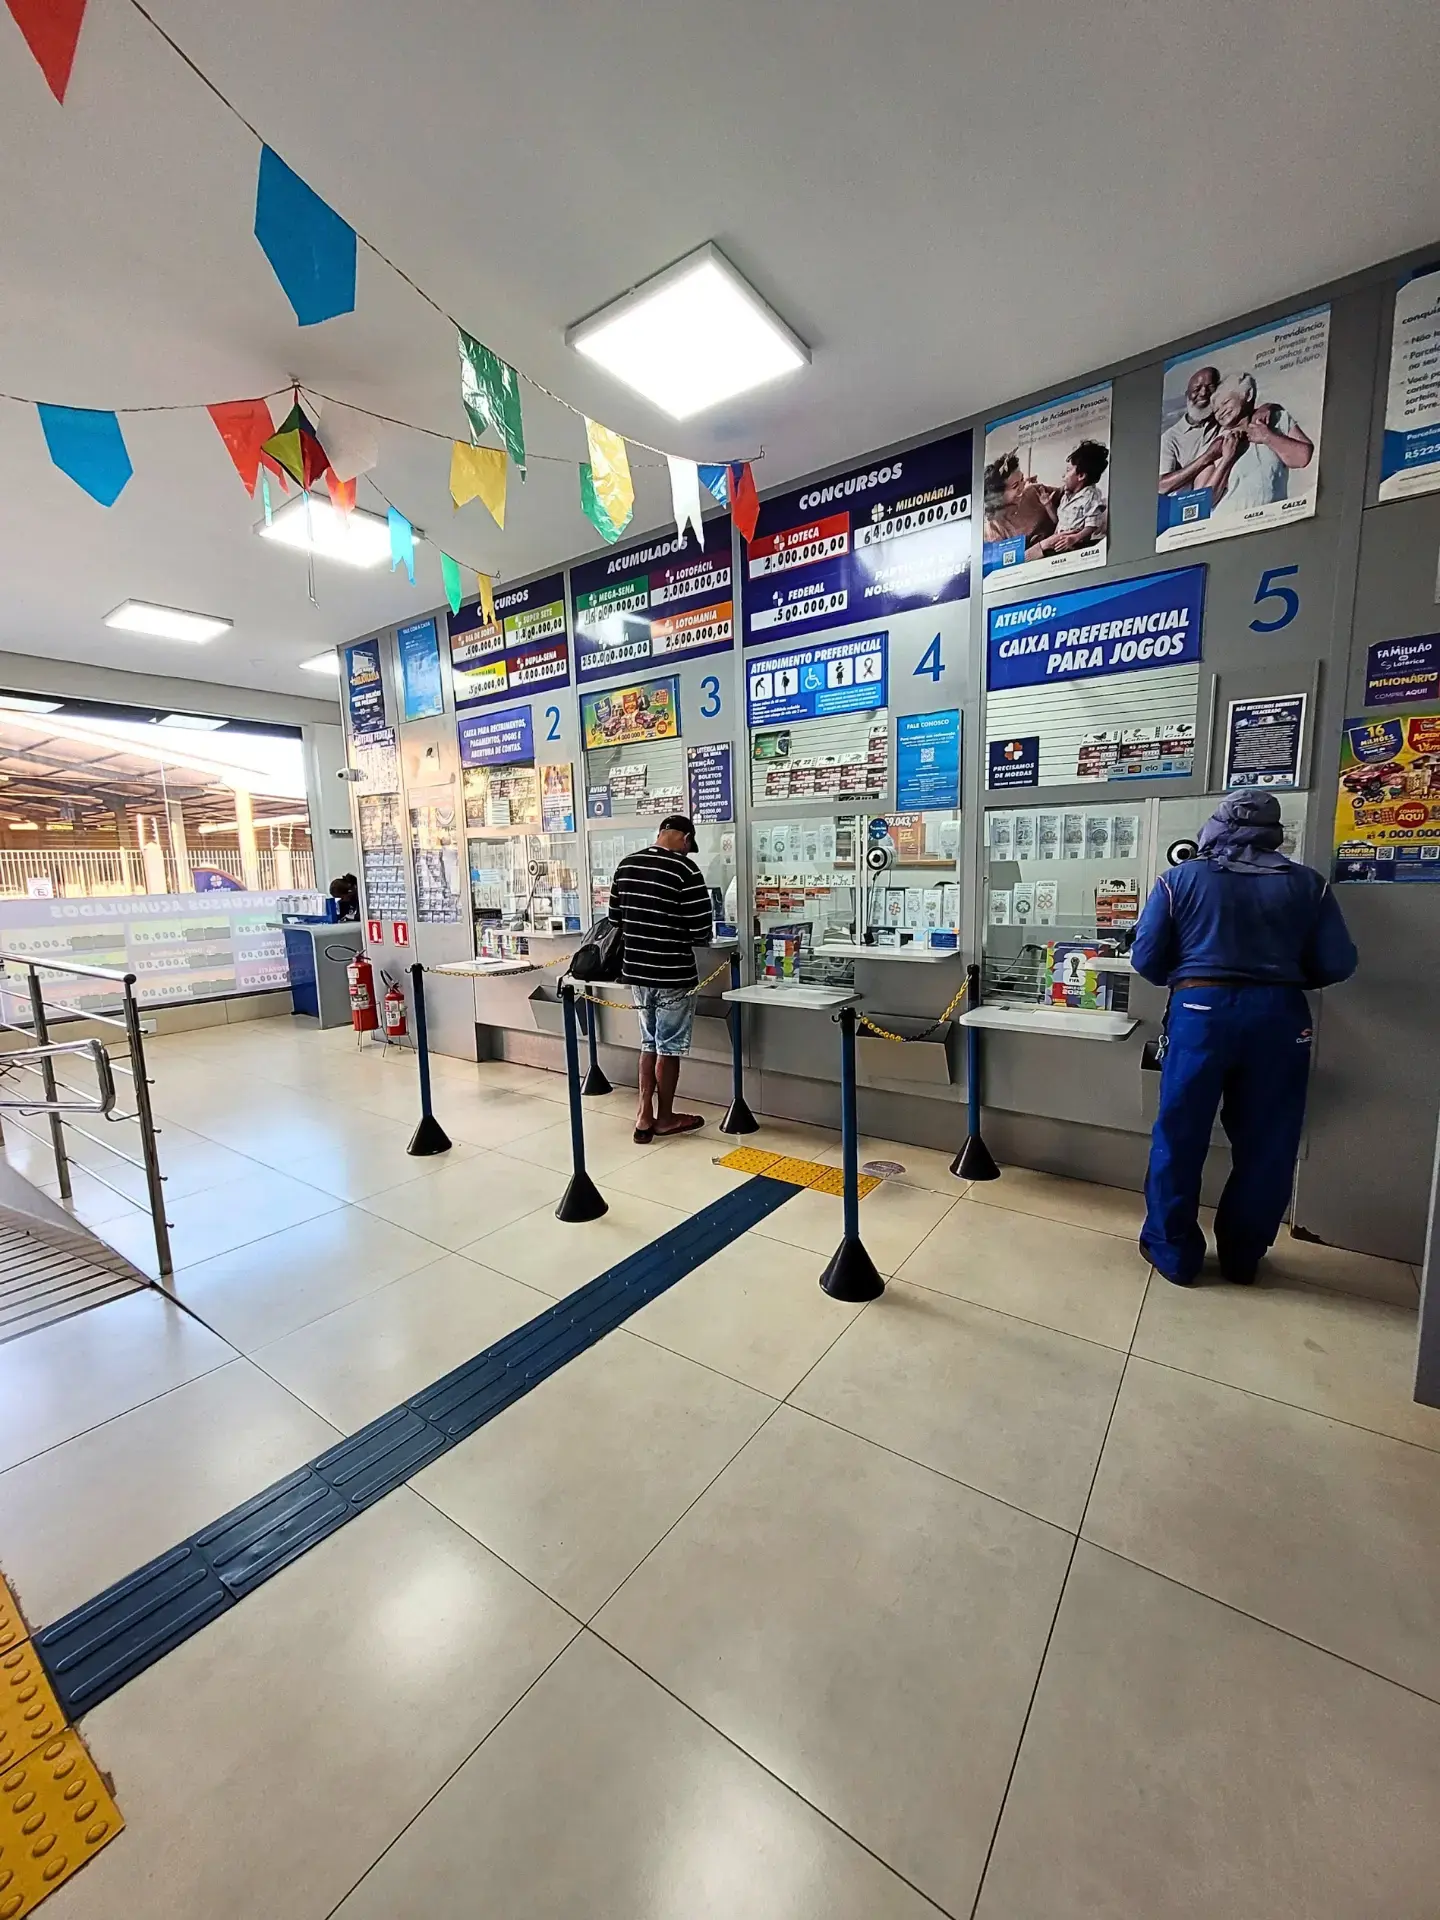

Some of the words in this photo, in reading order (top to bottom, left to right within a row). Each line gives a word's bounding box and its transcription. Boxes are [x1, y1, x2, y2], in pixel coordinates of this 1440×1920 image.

[1275, 322, 1325, 342] Previdência,
[1256, 348, 1275, 360] para
[1279, 337, 1307, 351] investir
[1310, 332, 1324, 340] nos
[1255, 360, 1271, 368] seus
[1274, 349, 1302, 361] sonhos
[1280, 362, 1294, 370] seu
[1019, 421, 1039, 431] Seguro
[1050, 406, 1079, 420] Acidentes
[799, 463, 902, 510] CONCURSOS
[896, 484, 954, 512] MILIONÁRIA
[1282, 499, 1307, 509] CAIXA
[864, 498, 967, 544] 64.000.000,00
[1244, 511, 1263, 519] CAIXA
[788, 526, 819, 545] LOTECA
[764, 536, 844, 570] 2.000.000,00
[1081, 549, 1099, 557] CAIXA
[676, 560, 713, 579] LOTOFÁCIL
[599, 584, 634, 602] MEGA-SENA
[663, 570, 728, 599] 2.000.000,00
[788, 583, 824, 601] FEDERAL
[477, 591, 528, 616] CCURSOS
[1249, 565, 1299, 633] 5
[541, 608, 552, 618] SETE
[675, 610, 717, 629] LOTOMANIA
[995, 603, 1056, 628] ATENÇÃO:
[465, 634, 473, 642] DIA
[666, 623, 729, 648] 2.600.000,00
[999, 632, 1049, 658] CAIXA
[1055, 608, 1189, 649] PREFERENCIAL
[525, 651, 556, 666] DUPLA-SENA
[751, 653, 812, 674] ATENDIMENTO
[814, 639, 881, 663] PREFERENCIAL
[913, 632, 945, 681] 4
[1046, 646, 1103, 674] PARA
[1109, 632, 1185, 665] JOGOS
[1369, 672, 1438, 688] MILIONÁRIO
[700, 676, 721, 717] 3
[1375, 691, 1404, 699] COMPRE
[464, 729, 476, 738] CAIXA
[478, 726, 489, 735] PARA
[546, 706, 560, 740] 2
[921, 719, 949, 728] CONOSCO
[1367, 725, 1385, 737] 16
[470, 736, 501, 748] PAGAMENTOS,
[502, 733, 517, 742] JOGOS
[518, 731, 521, 740] E
[471, 748, 494, 758] ABERTURA
[495, 746, 501, 754] DE
[502, 743, 521, 753] CONTAS.
[688, 759, 715, 767] ATENÇÃO
[993, 763, 1034, 771] PRECISAMOS
[1398, 813, 1424, 821] AQUI
